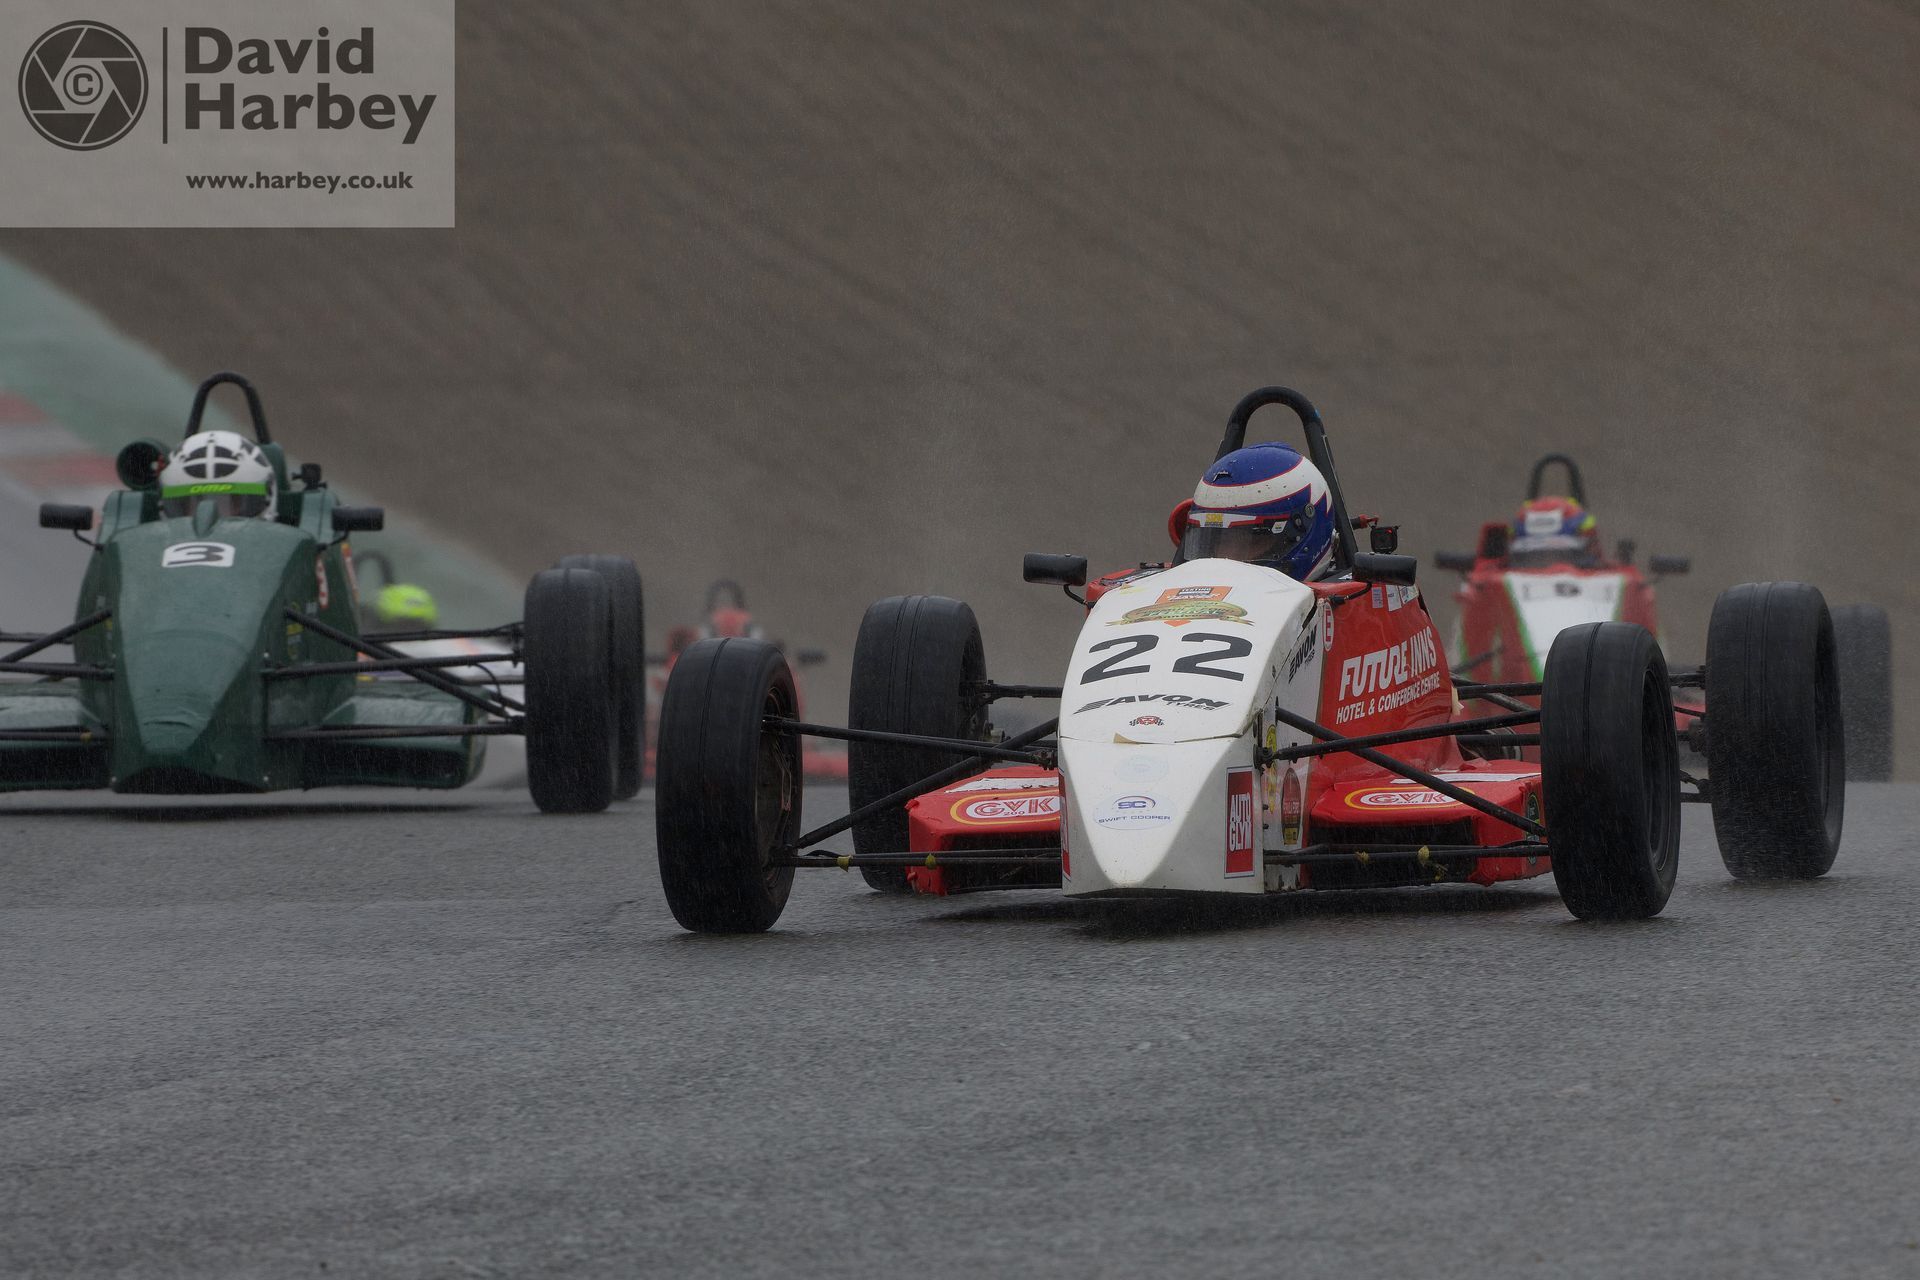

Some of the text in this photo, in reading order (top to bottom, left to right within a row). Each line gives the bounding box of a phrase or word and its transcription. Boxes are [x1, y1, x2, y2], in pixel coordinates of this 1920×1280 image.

[167, 545, 225, 565] 3
[1080, 632, 1252, 685] 22
[1339, 626, 1437, 701] FUTURE INNS
[1106, 694, 1229, 708] AVON
[1336, 671, 1440, 725] HOTEL & CONFERENCE CENTRE
[1098, 815, 1128, 823] SWIFT
